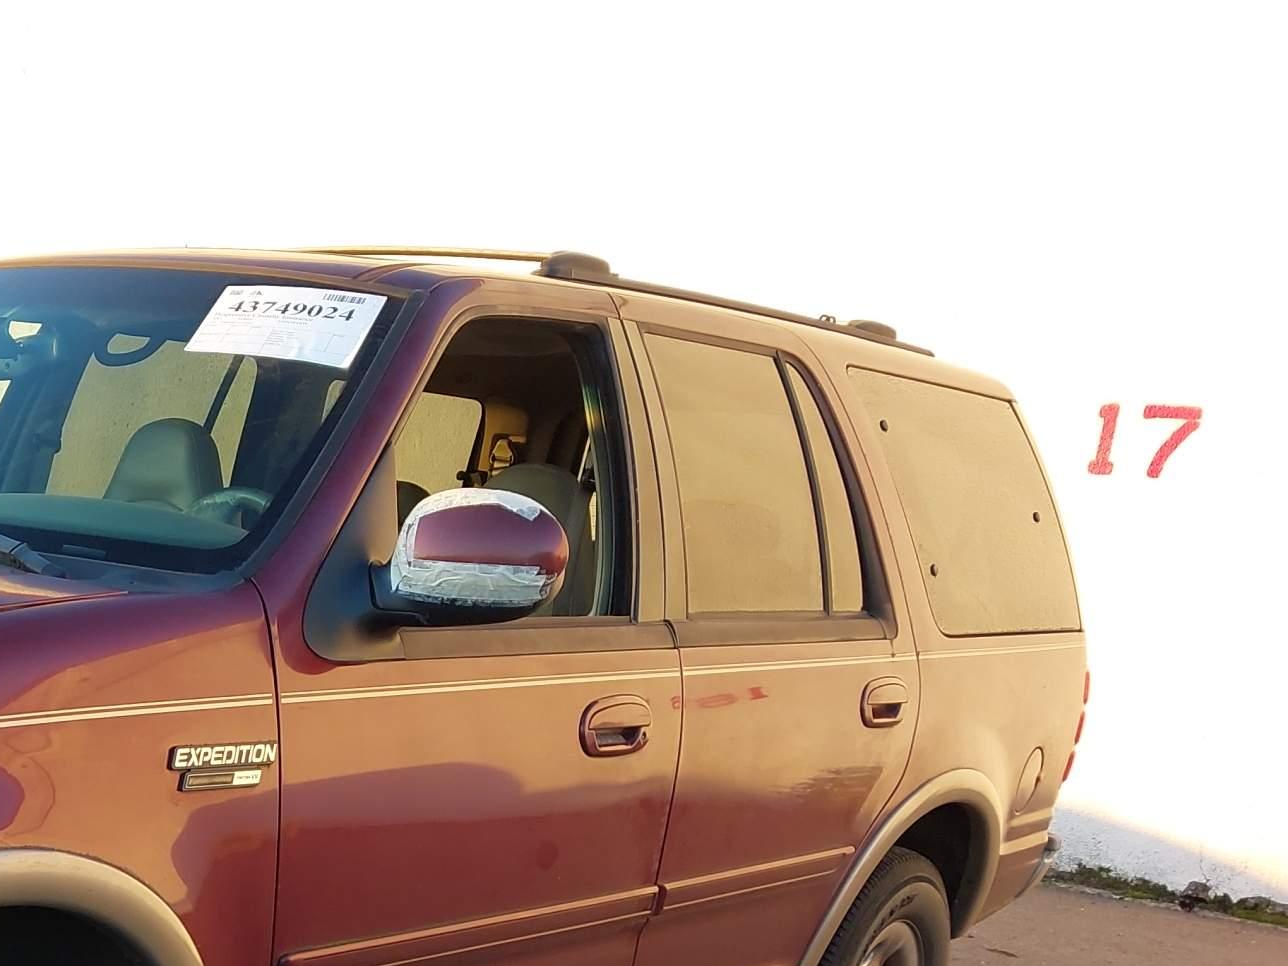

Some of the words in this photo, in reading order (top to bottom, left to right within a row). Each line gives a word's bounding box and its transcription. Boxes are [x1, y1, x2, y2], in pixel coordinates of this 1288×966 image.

[227, 299, 356, 322] 43749024
[1087, 403, 1203, 478] 17
[173, 743, 278, 768] EXPEDITION
